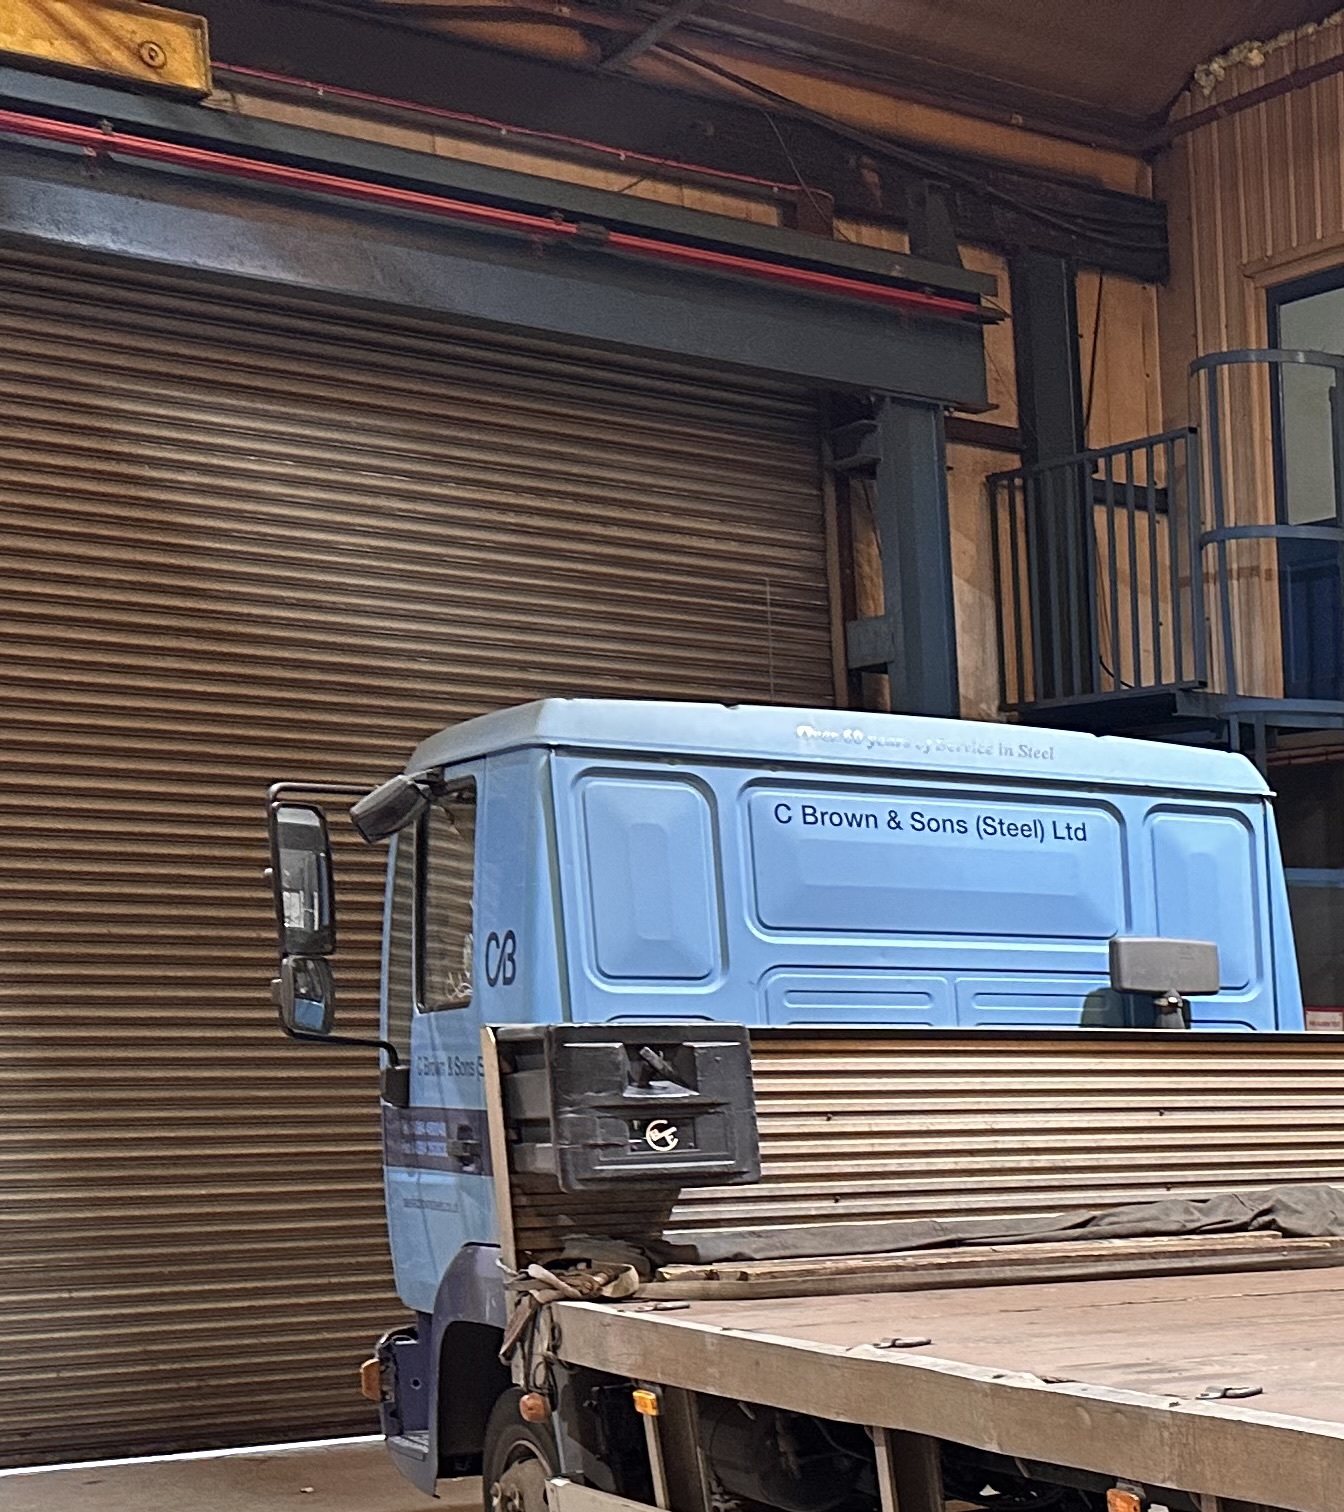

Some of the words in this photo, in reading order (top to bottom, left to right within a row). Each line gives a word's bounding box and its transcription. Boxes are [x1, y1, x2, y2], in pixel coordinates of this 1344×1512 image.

[999, 742, 1014, 757] in
[1017, 744, 1055, 761] Steel
[774, 803, 793, 824] C
[802, 805, 878, 829] Brown
[887, 810, 904, 831] &
[910, 811, 968, 834] Sons
[976, 815, 1045, 843] (Steel)
[1052, 820, 1087, 842] Ltd
